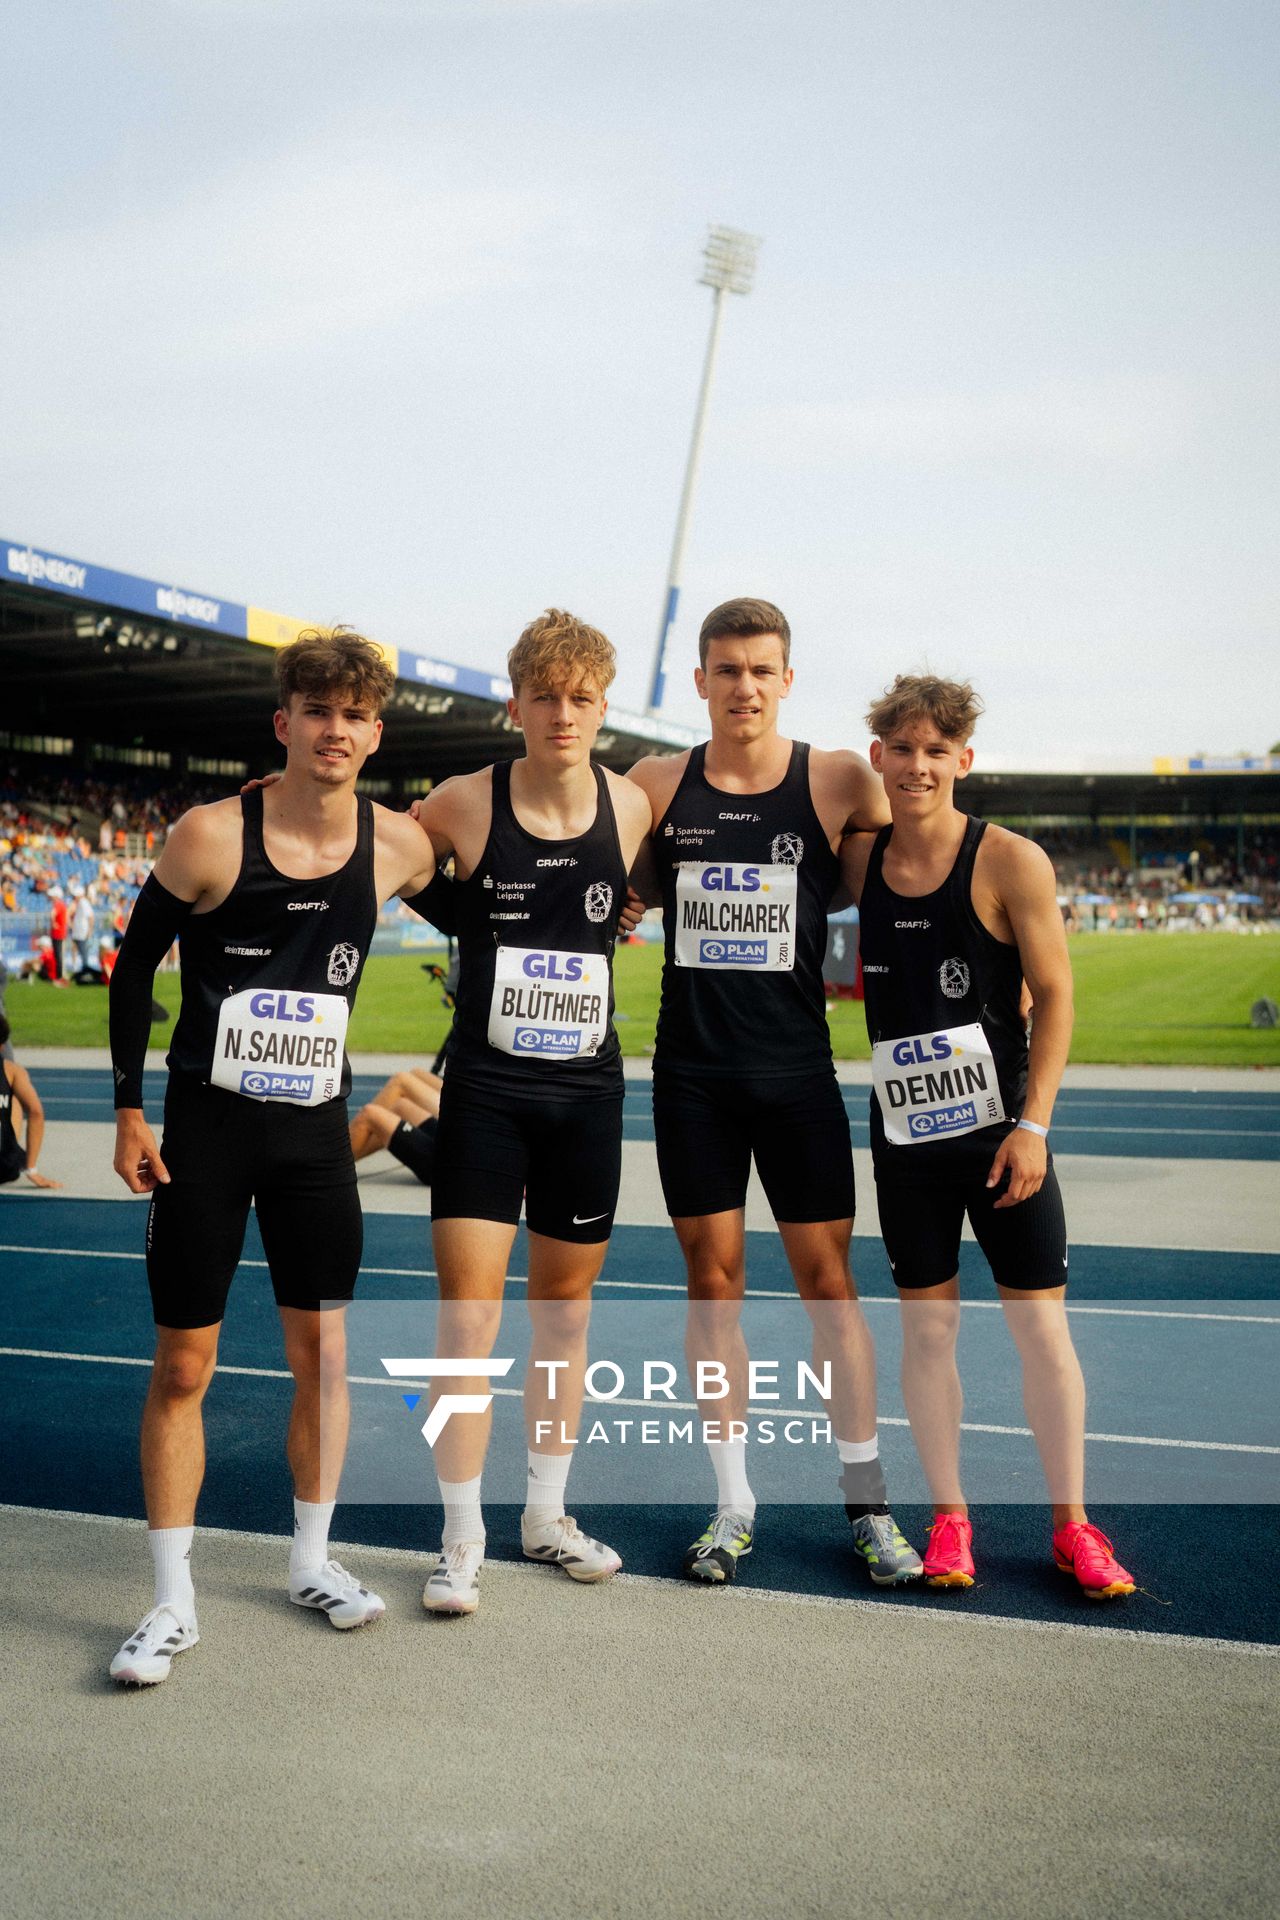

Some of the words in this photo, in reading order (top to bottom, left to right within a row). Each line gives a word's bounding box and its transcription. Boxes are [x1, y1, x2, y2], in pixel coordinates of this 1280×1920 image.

[719, 812, 752, 821] CRAFT
[676, 827, 716, 836] Sparkasse
[676, 838, 703, 846] Leipzig
[536, 858, 570, 867] CRAFT
[496, 881, 536, 893] Sparkasse
[496, 892, 525, 901] Leipzig
[287, 902, 321, 911] CRAFT
[682, 900, 791, 933] MALCHAREK
[894, 921, 924, 929] CRAFT
[727, 944, 765, 956] PLAN
[500, 983, 602, 1024] BLÜTHNER
[543, 1033, 579, 1046] PLAN
[223, 1027, 338, 1069] N.SANDER
[271, 1077, 311, 1092] PLAN
[323, 1077, 335, 1100] 1027
[884, 1062, 989, 1109] DEMIN
[985, 1096, 998, 1119] 1012
[935, 1106, 974, 1125] PLAN
[937, 1118, 975, 1130] INTERNATIONAL
